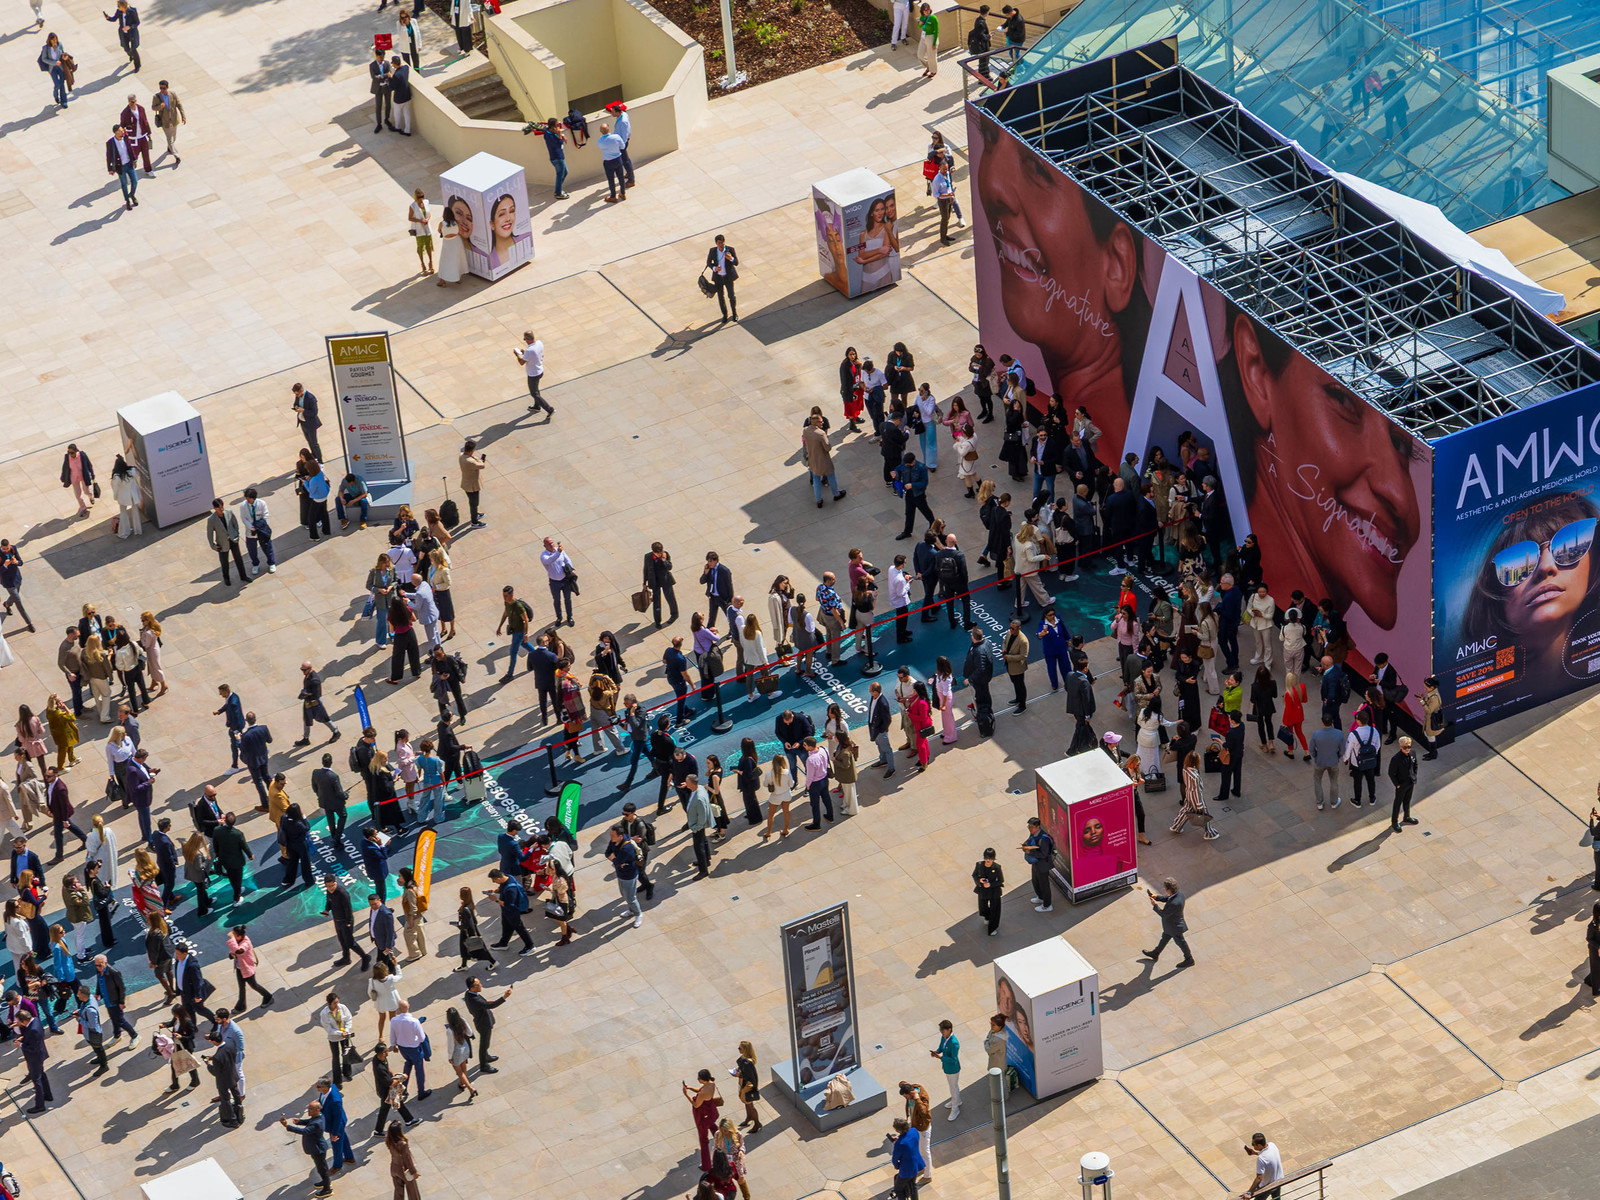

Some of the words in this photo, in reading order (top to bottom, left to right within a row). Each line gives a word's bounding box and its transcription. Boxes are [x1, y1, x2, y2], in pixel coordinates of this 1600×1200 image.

[1014, 247, 1114, 337] Signature
[340, 343, 379, 356] AMWC
[1181, 337, 1190, 352] A
[1456, 505, 1494, 521] AESTHETIC
[1501, 486, 1541, 506] ANTI-AGING
[1541, 474, 1574, 491] MEDICINE
[1574, 465, 1598, 479] WORLD
[1287, 464, 1403, 564] Signature
[1502, 508, 1528, 525] OPEN
[1531, 504, 1543, 515] TO
[1544, 497, 1561, 511] THE
[1563, 484, 1595, 503] WORLD
[1456, 635, 1498, 659] AMWC
[1456, 671, 1477, 683] SAVE
[1477, 665, 1494, 676] 20%
[343, 840, 362, 859] you
[316, 845, 337, 863] the
[330, 862, 357, 886] next
[807, 913, 840, 933] Mastelli
[1057, 998, 1085, 1011] SCIENCE
